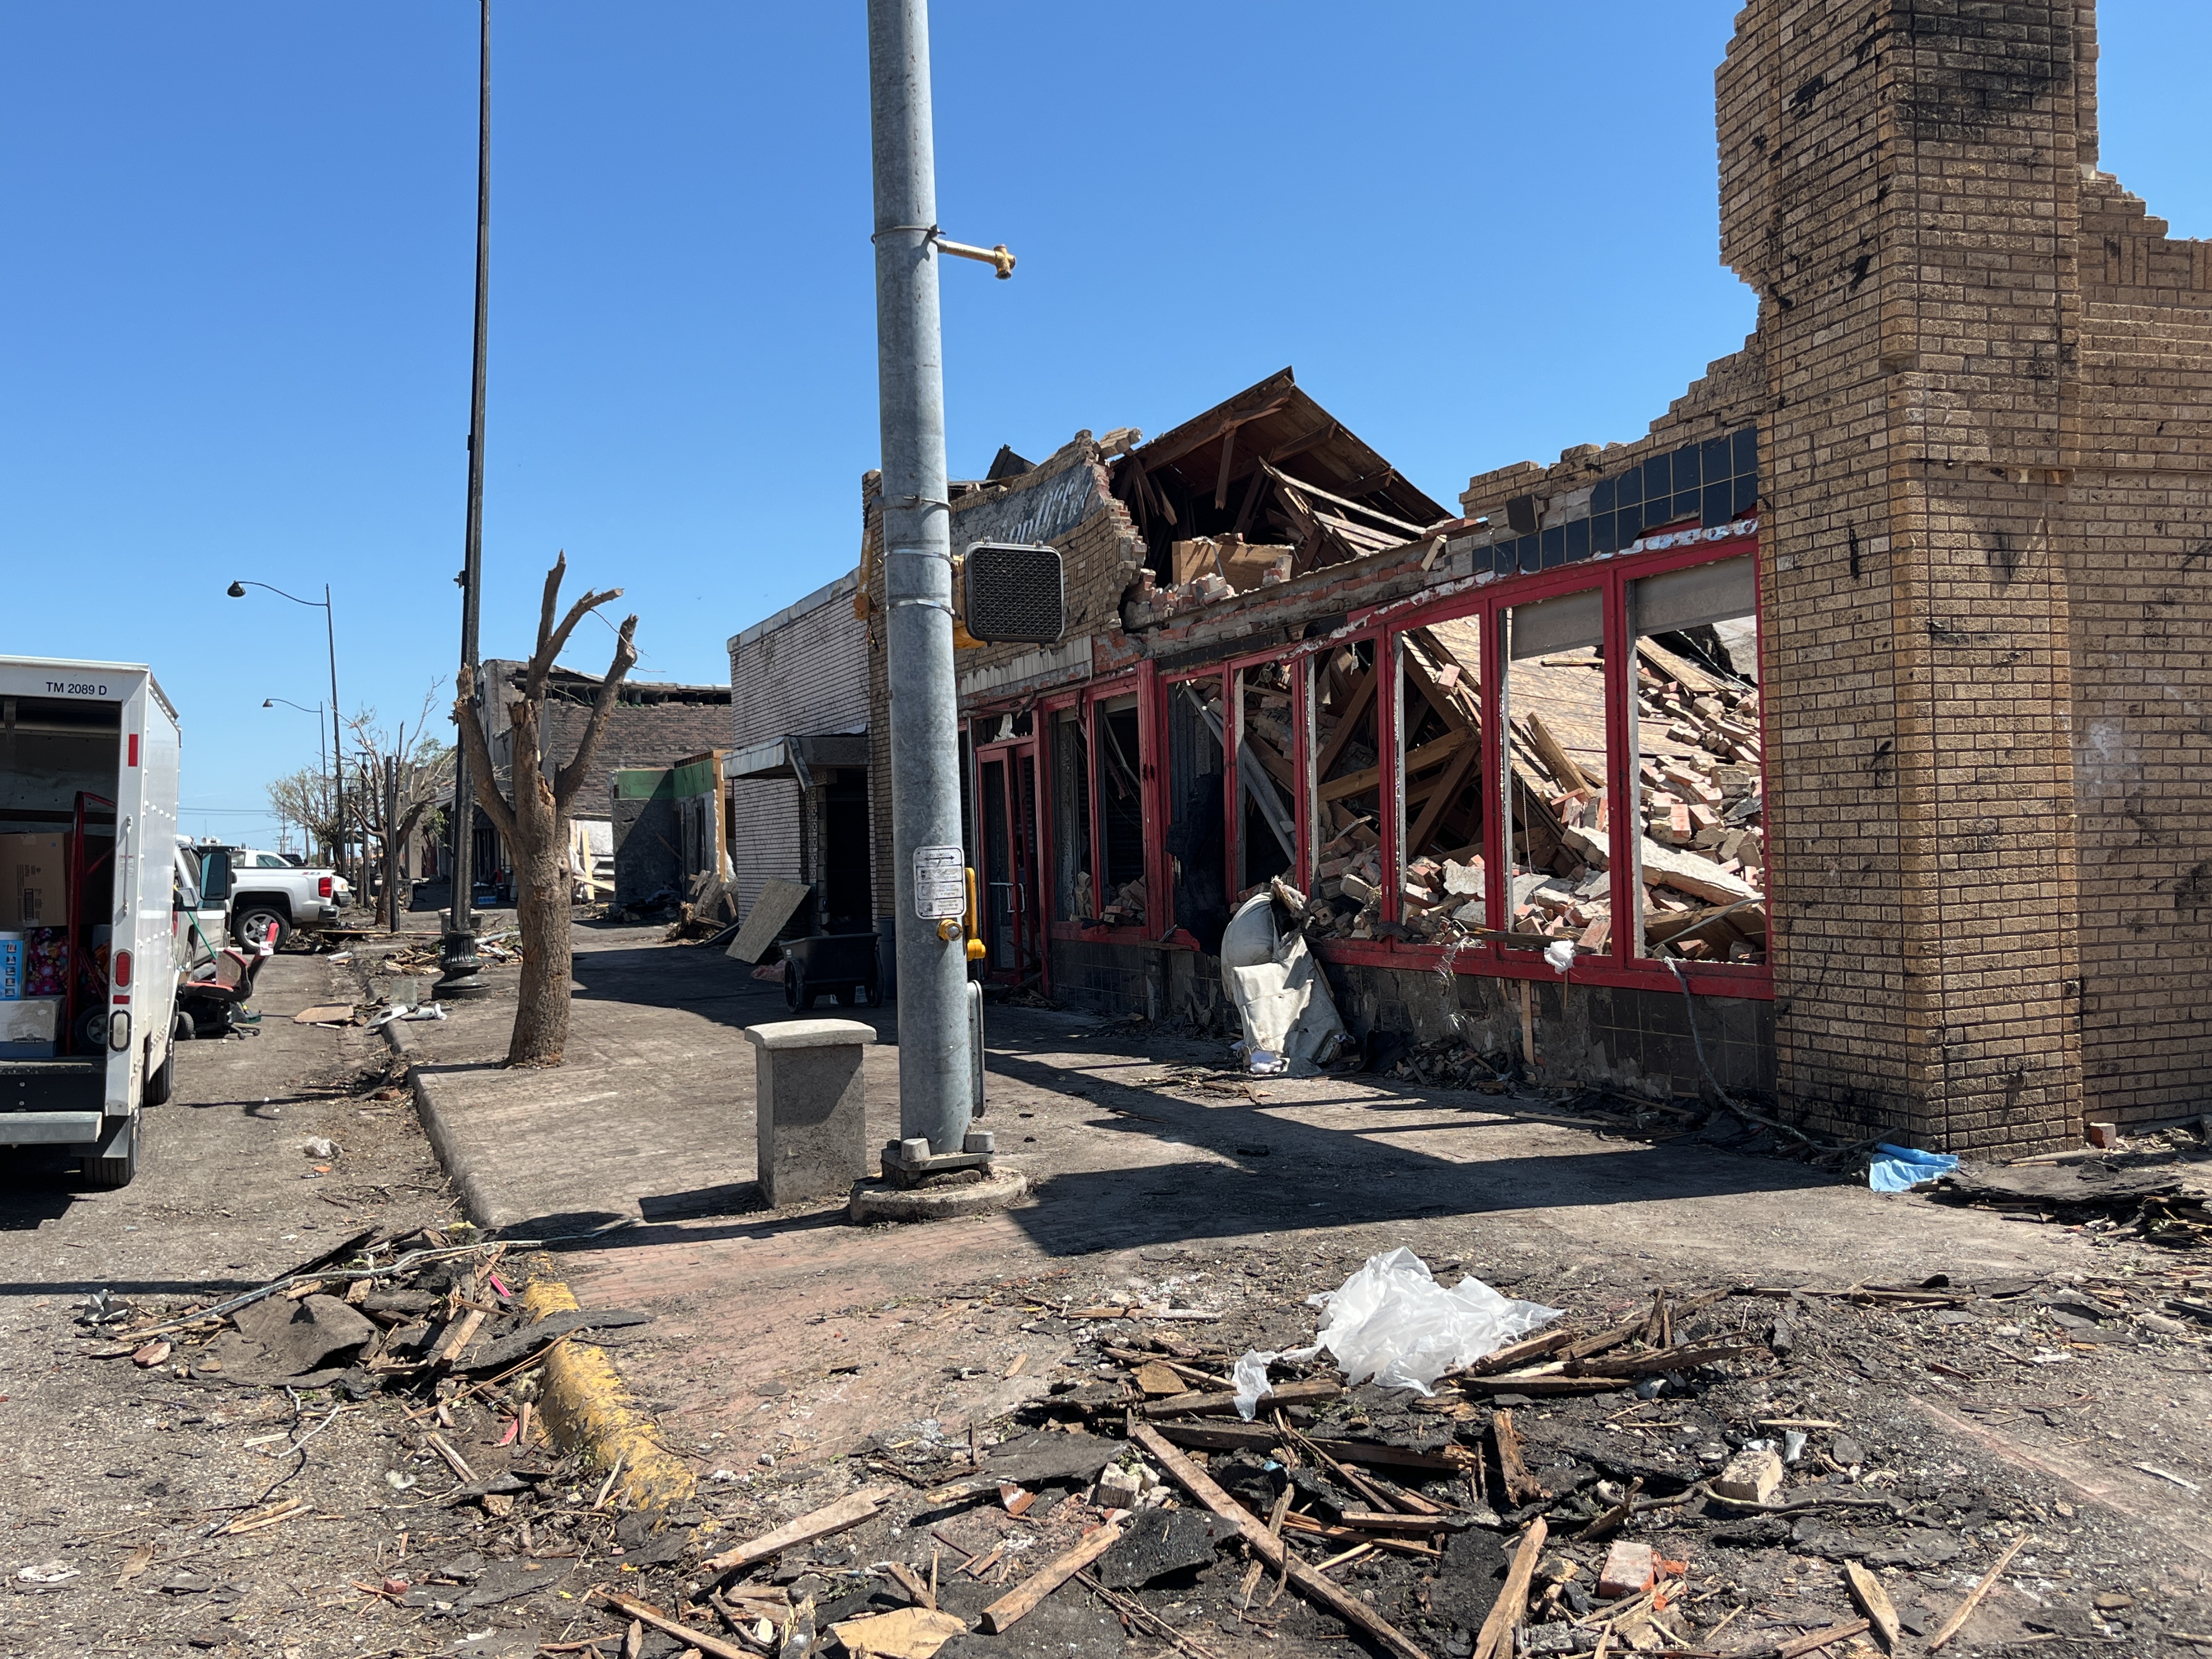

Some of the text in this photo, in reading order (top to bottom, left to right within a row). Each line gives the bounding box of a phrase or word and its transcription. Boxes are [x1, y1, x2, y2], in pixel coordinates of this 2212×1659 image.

[46, 681, 107, 695] TM 2089 D
